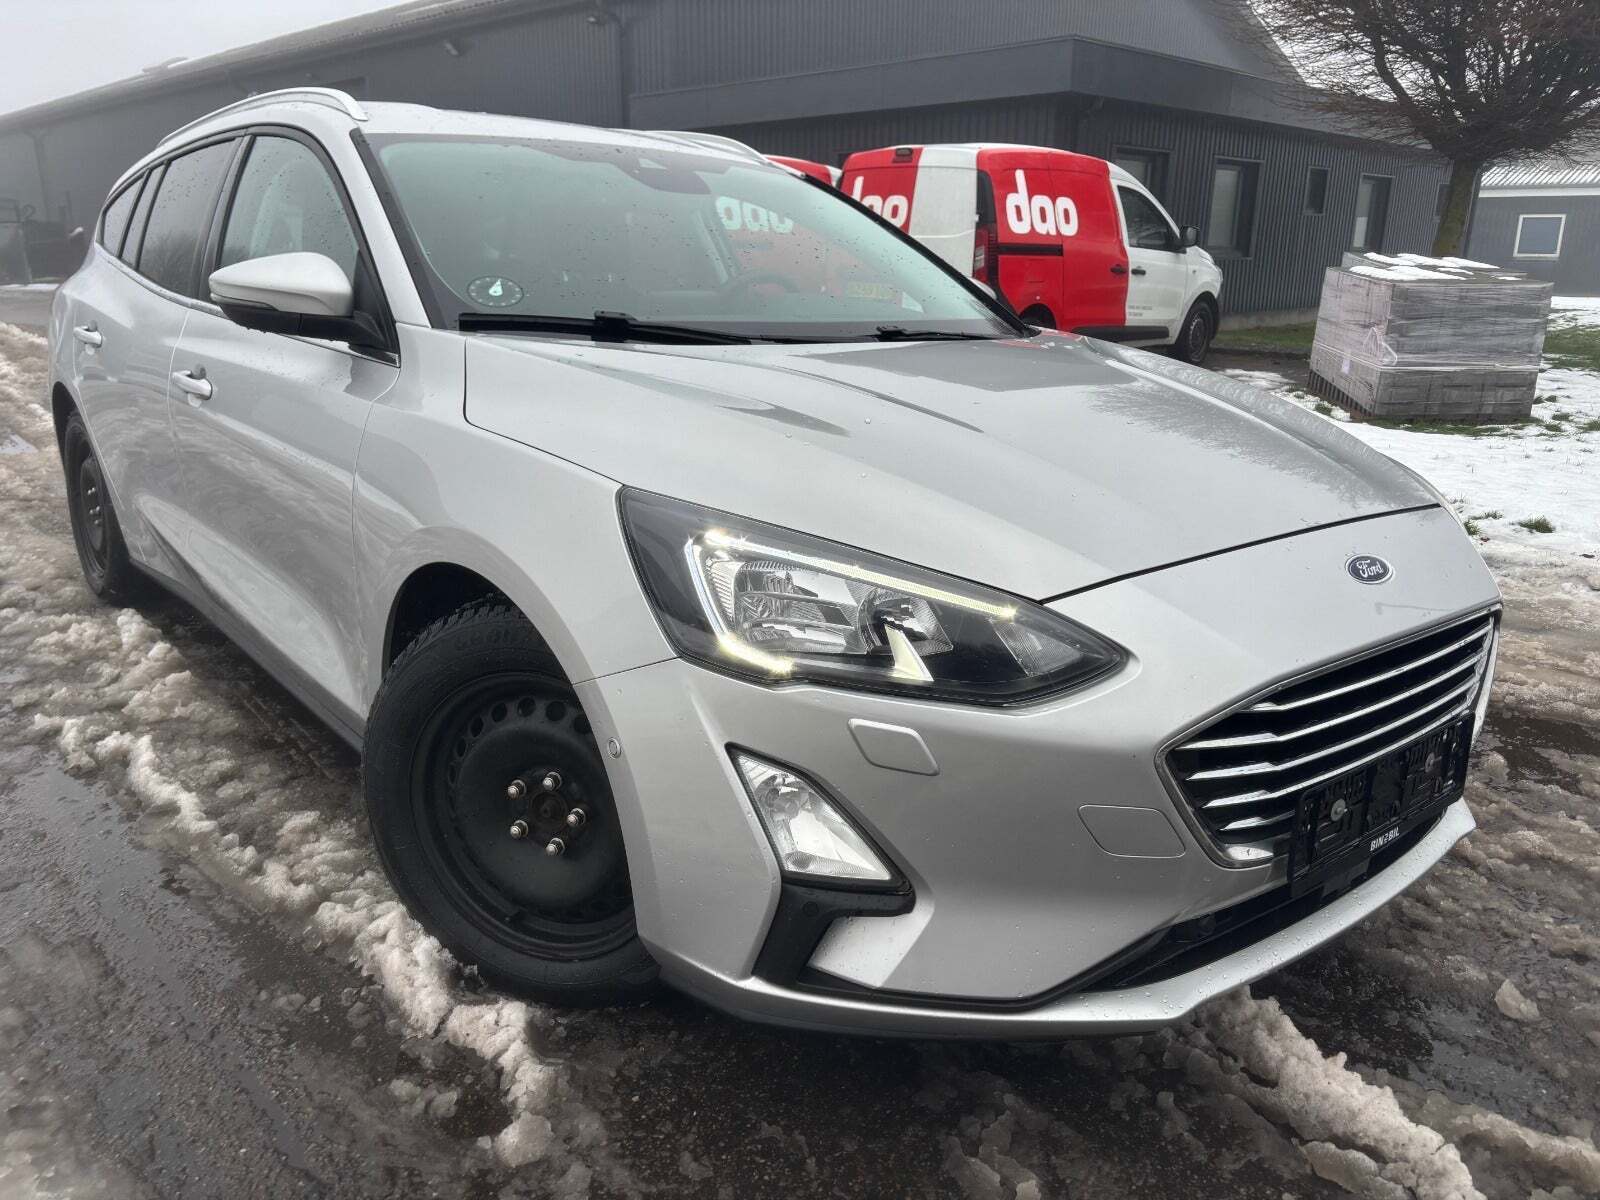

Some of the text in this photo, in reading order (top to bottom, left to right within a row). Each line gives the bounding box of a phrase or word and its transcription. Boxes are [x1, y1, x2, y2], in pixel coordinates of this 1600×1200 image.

[1006, 169, 1079, 237] dao
[1356, 559, 1385, 579] Ford
[1369, 826, 1400, 852] BIN2BIL
